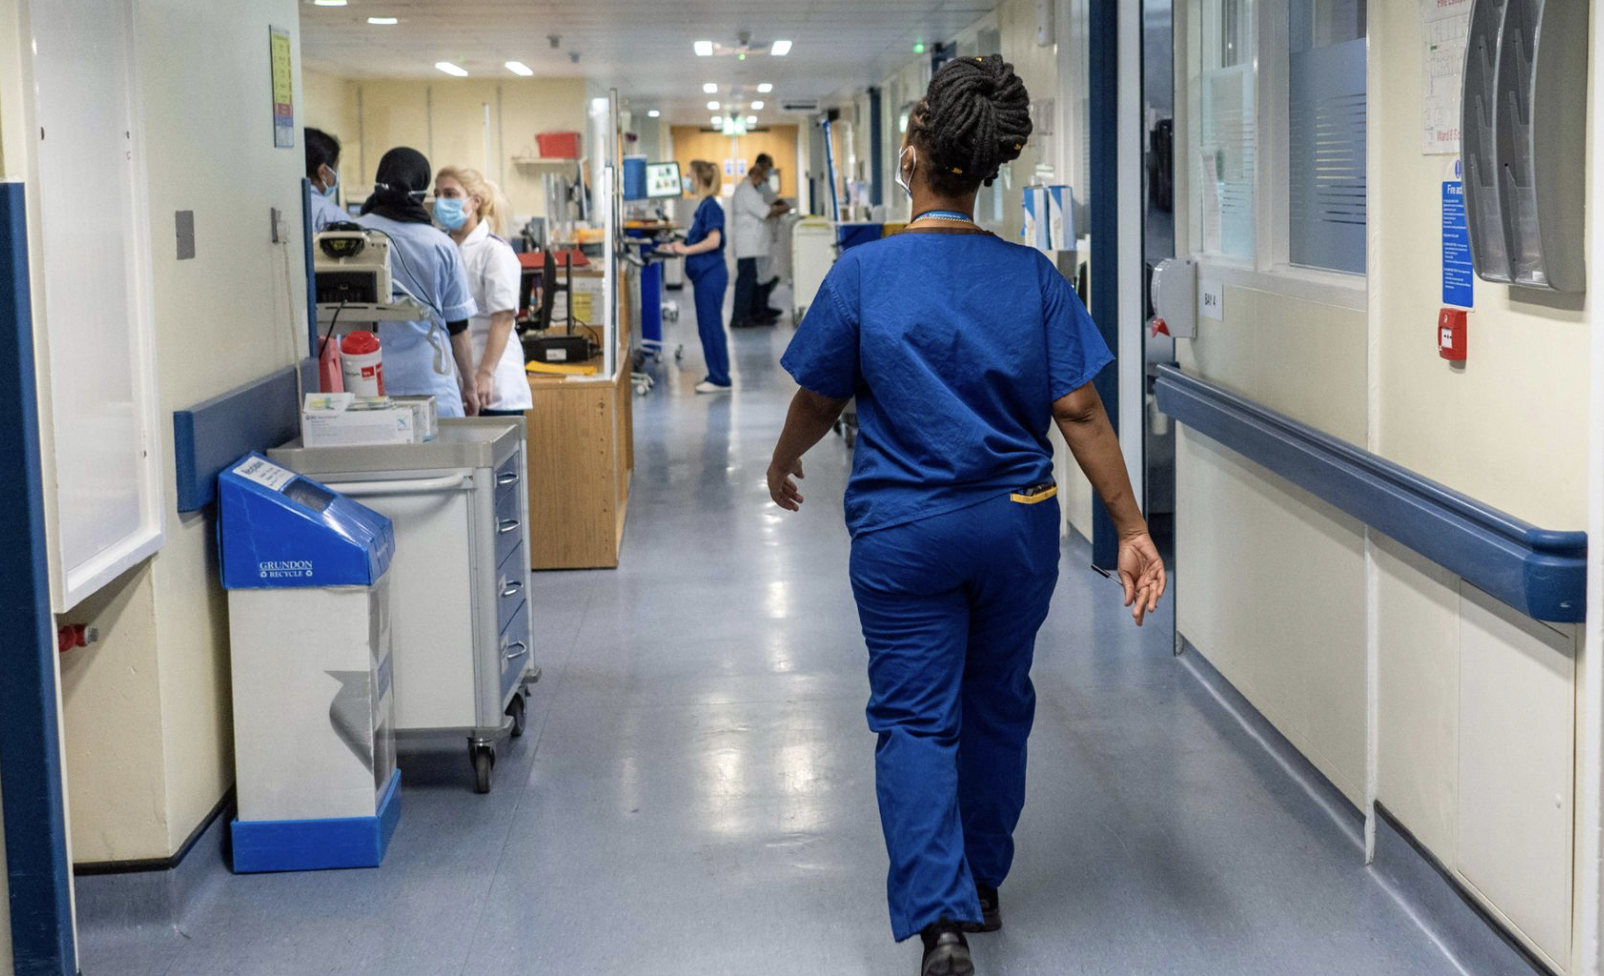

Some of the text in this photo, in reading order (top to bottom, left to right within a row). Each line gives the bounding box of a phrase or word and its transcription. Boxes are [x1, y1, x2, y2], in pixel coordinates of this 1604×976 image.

[1447, 184, 1455, 193] Fire
[1213, 295, 1216, 306] 4
[260, 560, 313, 569] GRUNDON
